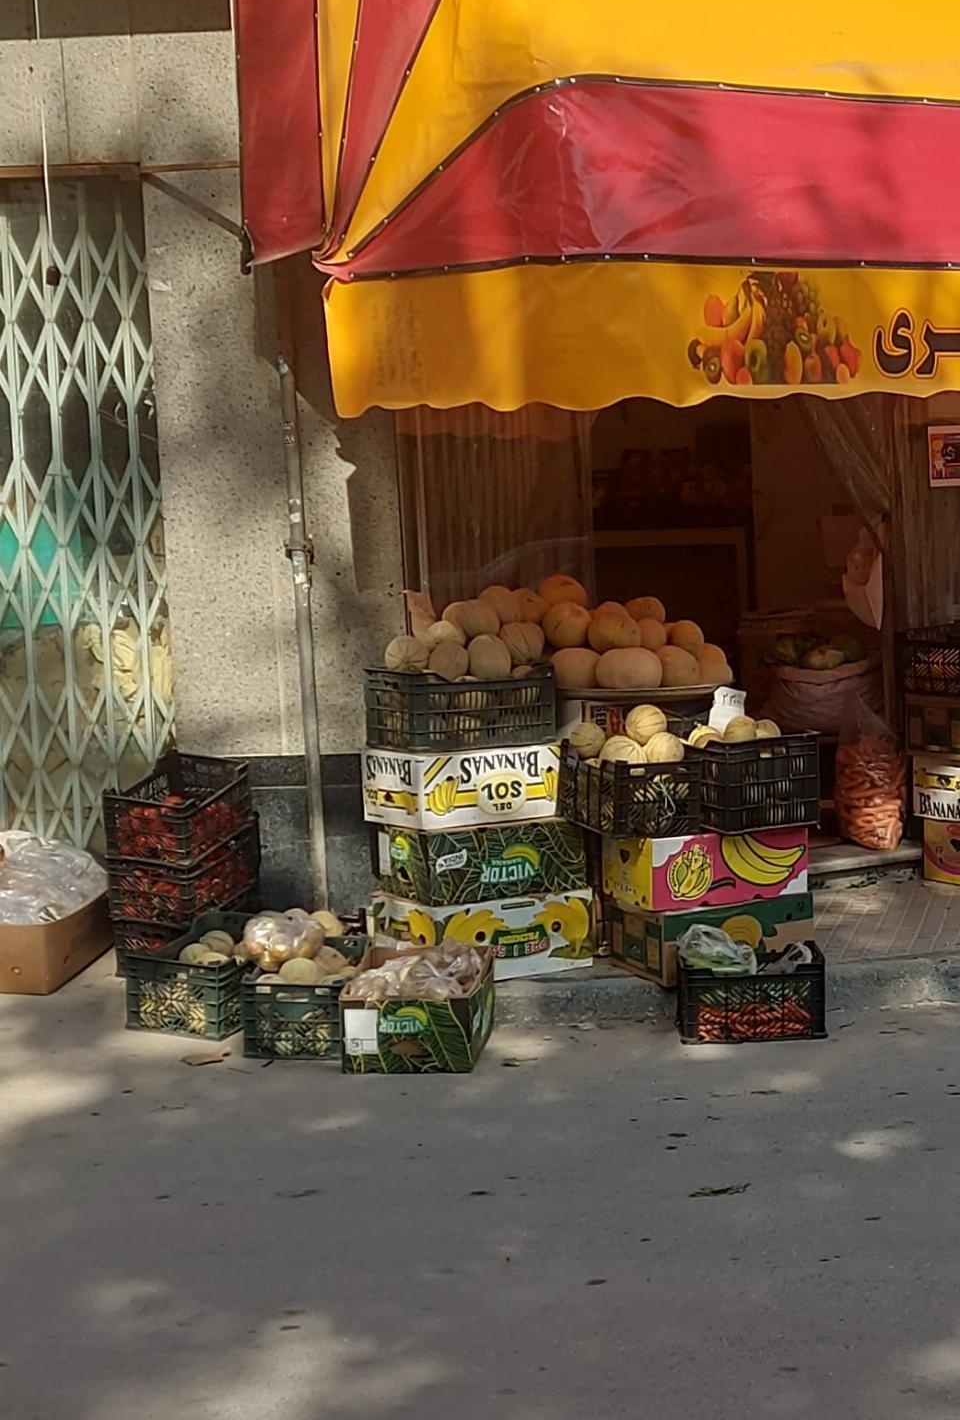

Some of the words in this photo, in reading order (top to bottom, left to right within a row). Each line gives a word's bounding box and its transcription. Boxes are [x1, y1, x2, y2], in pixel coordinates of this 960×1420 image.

[365, 754, 412, 787] BANANAS
[459, 749, 541, 786] BANANAS
[480, 779, 523, 801] SOL
[492, 801, 513, 811] DEL
[480, 861, 536, 883] VICTOR
[378, 1018, 424, 1034] VICTOR
